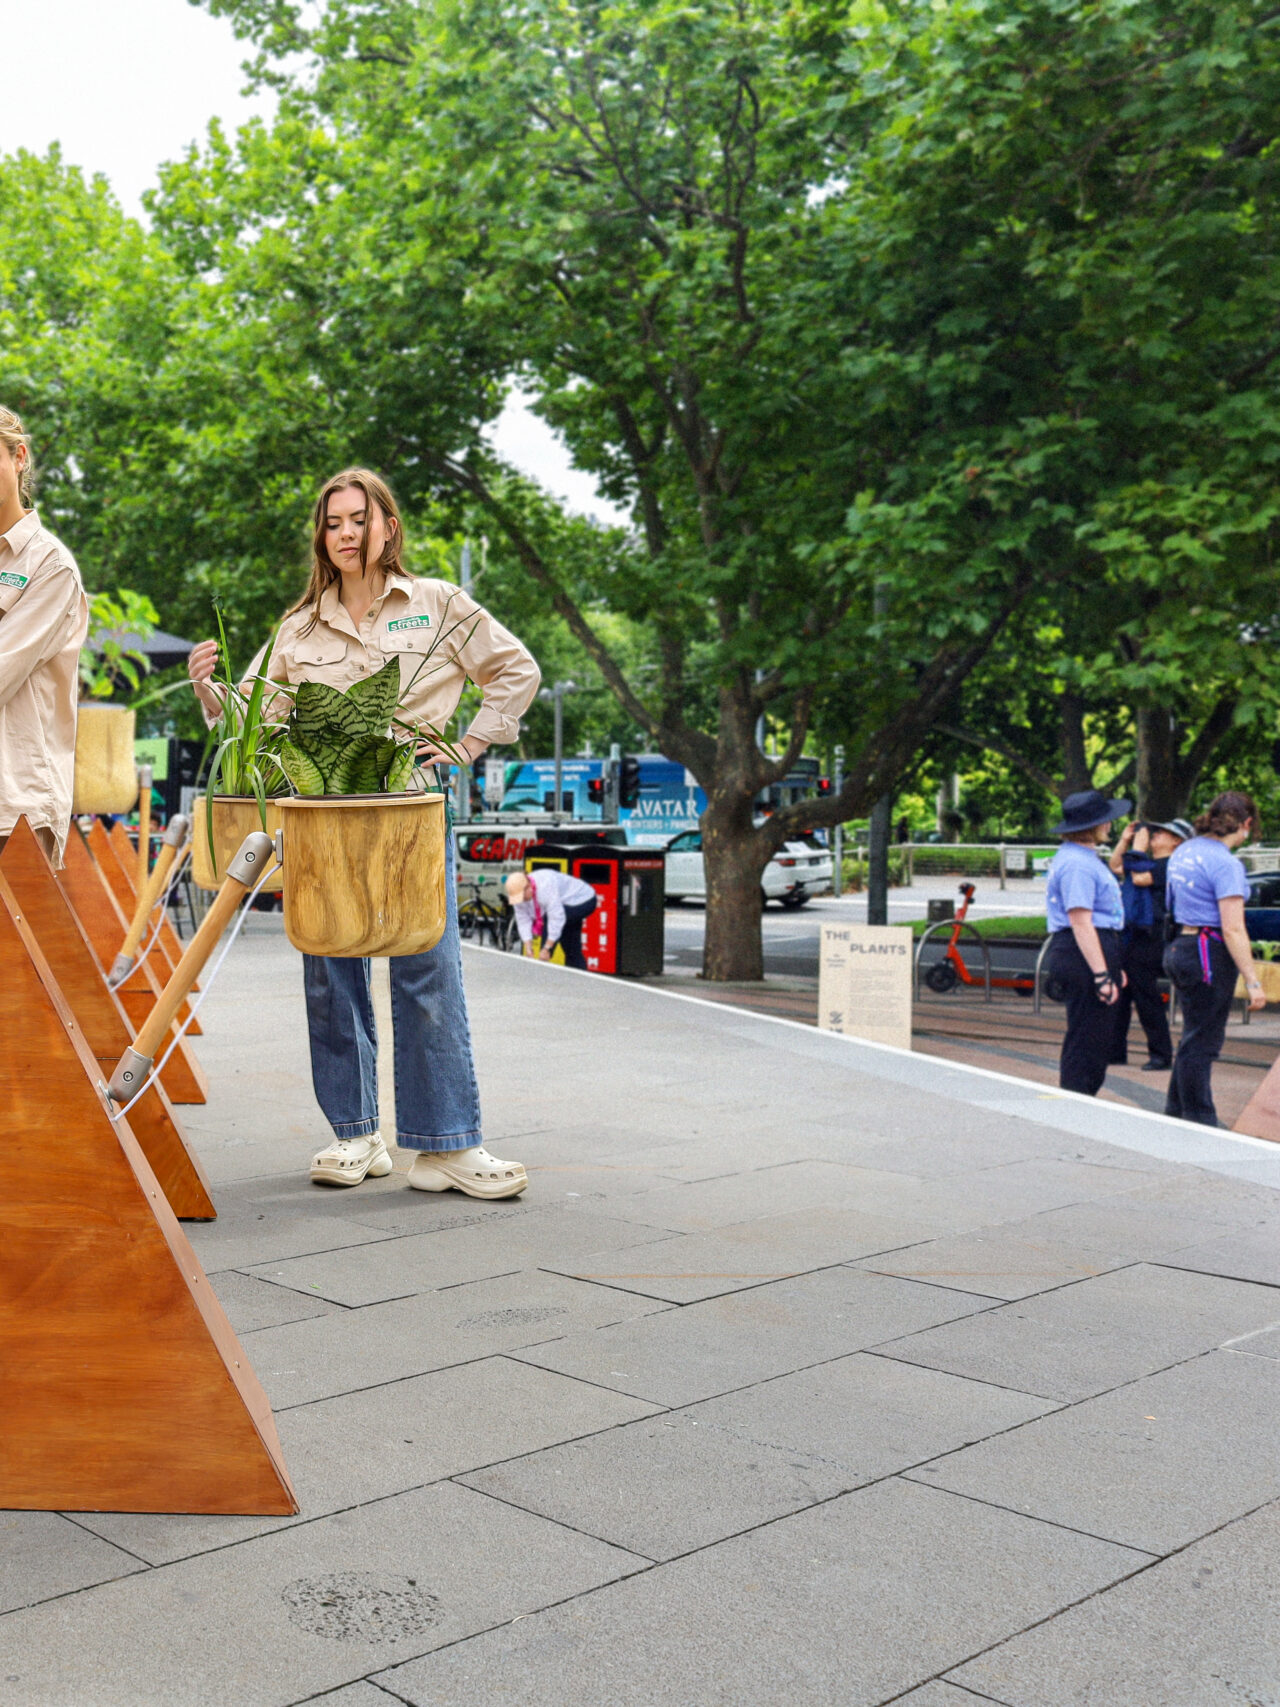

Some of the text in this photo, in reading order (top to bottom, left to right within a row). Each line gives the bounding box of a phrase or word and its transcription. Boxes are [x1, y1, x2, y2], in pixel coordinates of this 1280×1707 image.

[630, 799, 700, 818] AVATAR
[825, 930, 850, 940] THE
[850, 943, 906, 955] PLANTS
